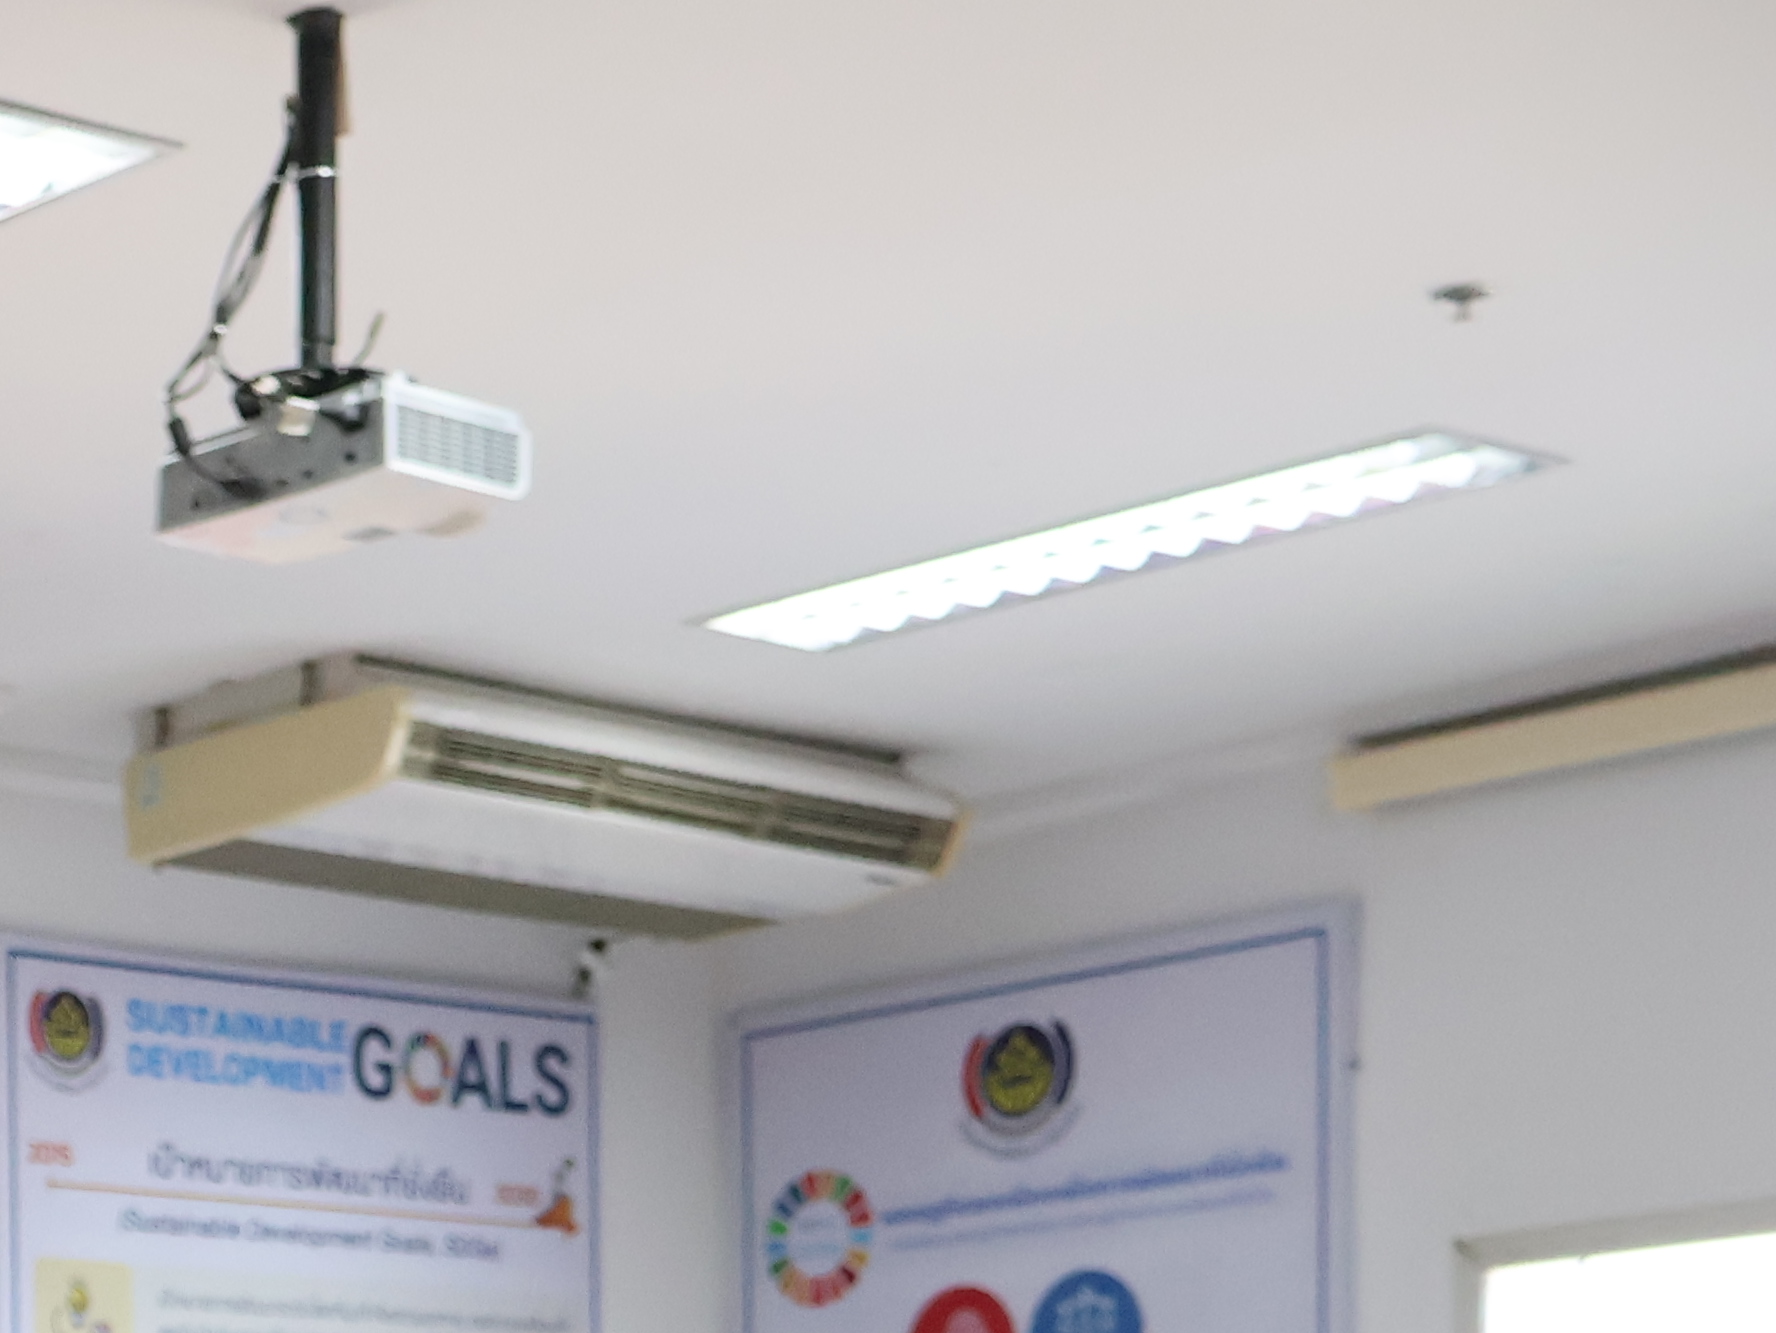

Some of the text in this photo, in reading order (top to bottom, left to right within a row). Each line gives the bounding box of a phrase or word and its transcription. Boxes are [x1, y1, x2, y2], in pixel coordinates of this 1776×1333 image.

[124, 998, 345, 1053] SUSTAINABLE
[125, 1043, 344, 1093] DEVELOPMENT
[352, 1024, 573, 1117] GOALS
